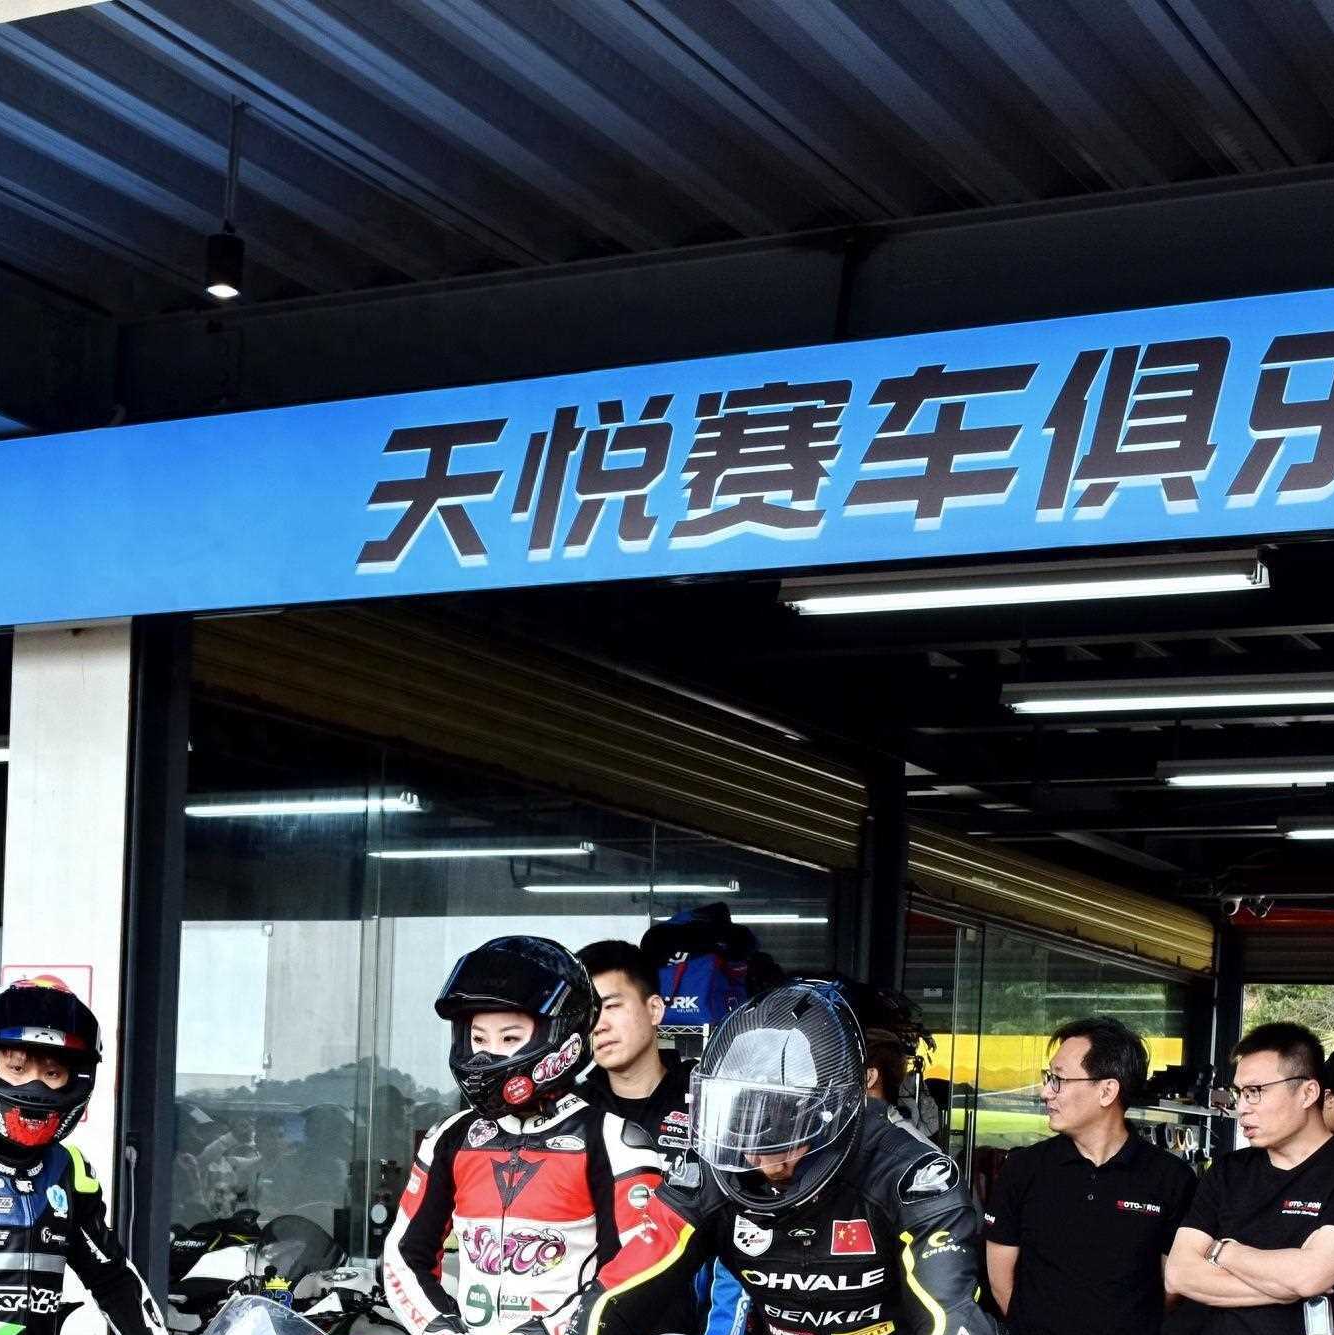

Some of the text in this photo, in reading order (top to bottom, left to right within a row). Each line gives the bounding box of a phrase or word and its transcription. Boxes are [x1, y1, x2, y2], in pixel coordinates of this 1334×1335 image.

[1117, 1200, 1161, 1213] MOTO-TRON
[741, 1267, 886, 1291] OHVALE
[470, 1290, 487, 1302] one
[764, 1303, 882, 1326] BENKIA
